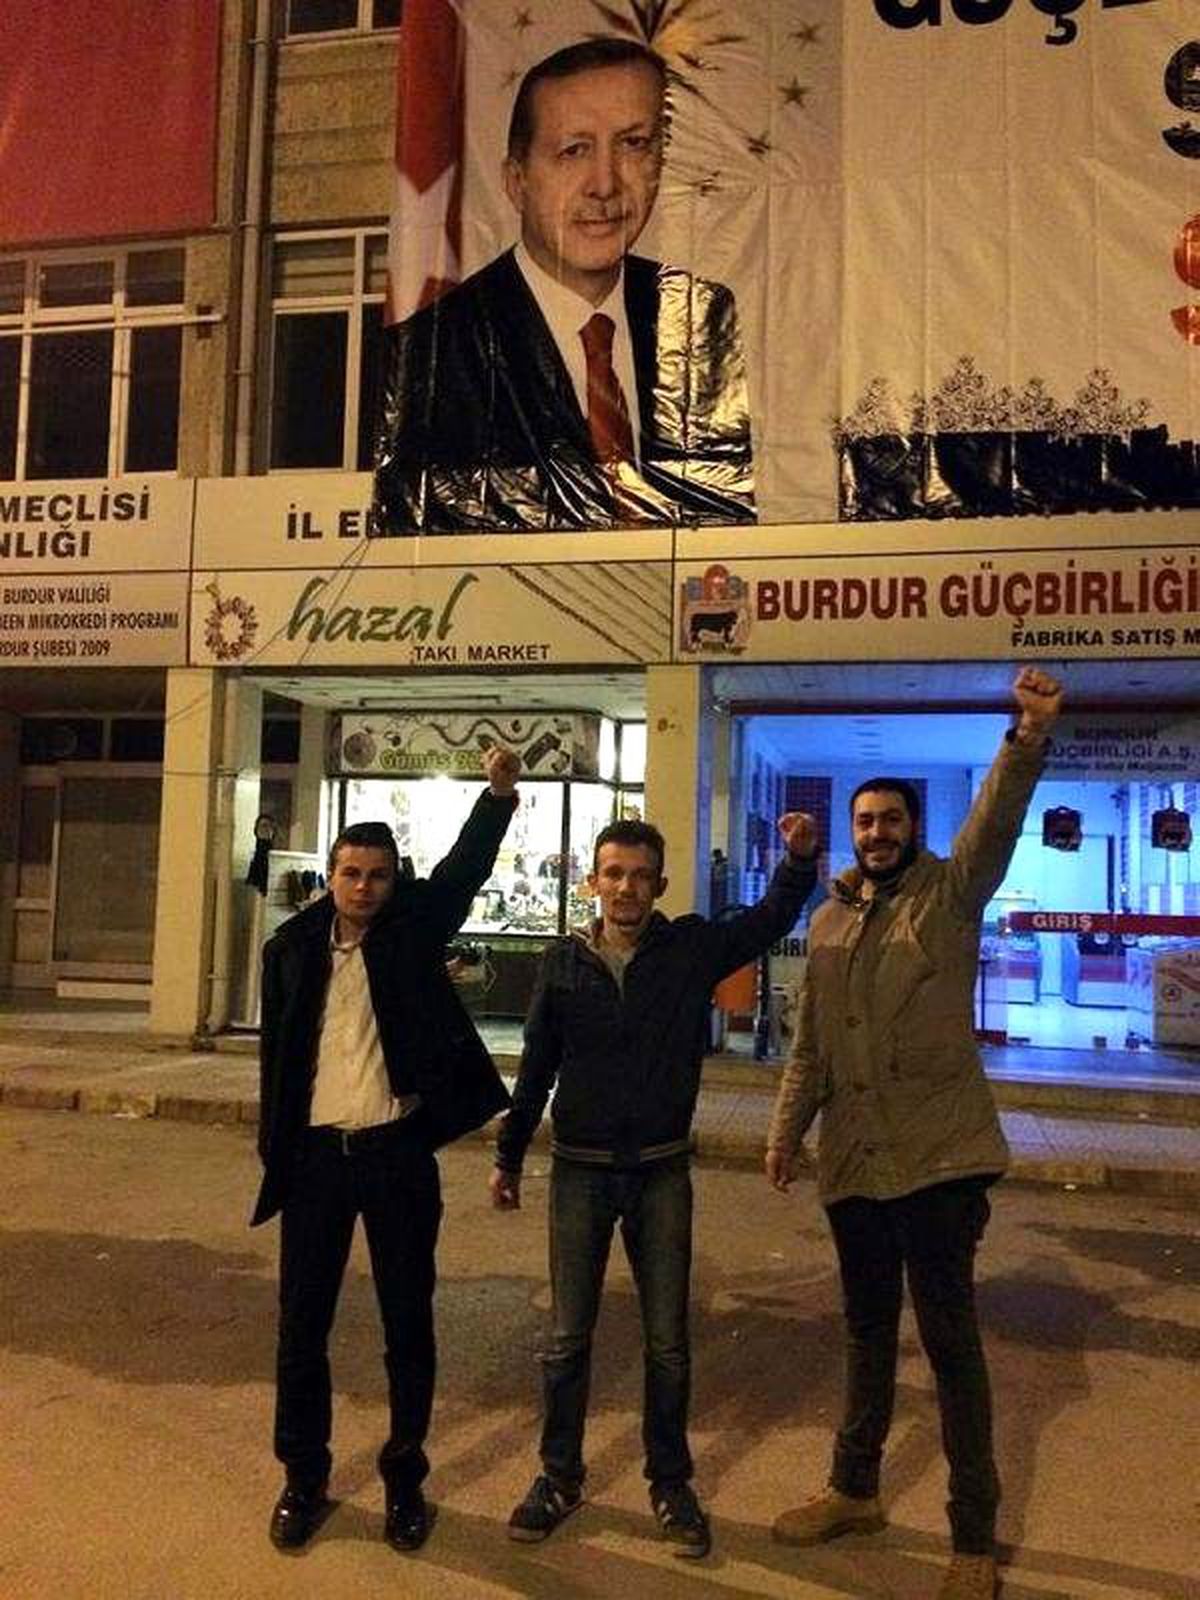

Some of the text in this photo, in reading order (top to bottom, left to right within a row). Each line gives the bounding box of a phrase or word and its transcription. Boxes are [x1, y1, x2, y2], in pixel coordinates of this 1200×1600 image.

[0, 485, 149, 523] MECLİSİ
[286, 503, 373, 539] İL E
[4, 587, 55, 605] BURDUR
[756, 555, 1199, 630] BURDUR GÜÇBİRLİĞİ
[111, 611, 179, 629] PROGRAMI
[286, 573, 479, 643] hazal
[80, 640, 111, 657] 2009
[413, 643, 551, 662] TAKI MARKET
